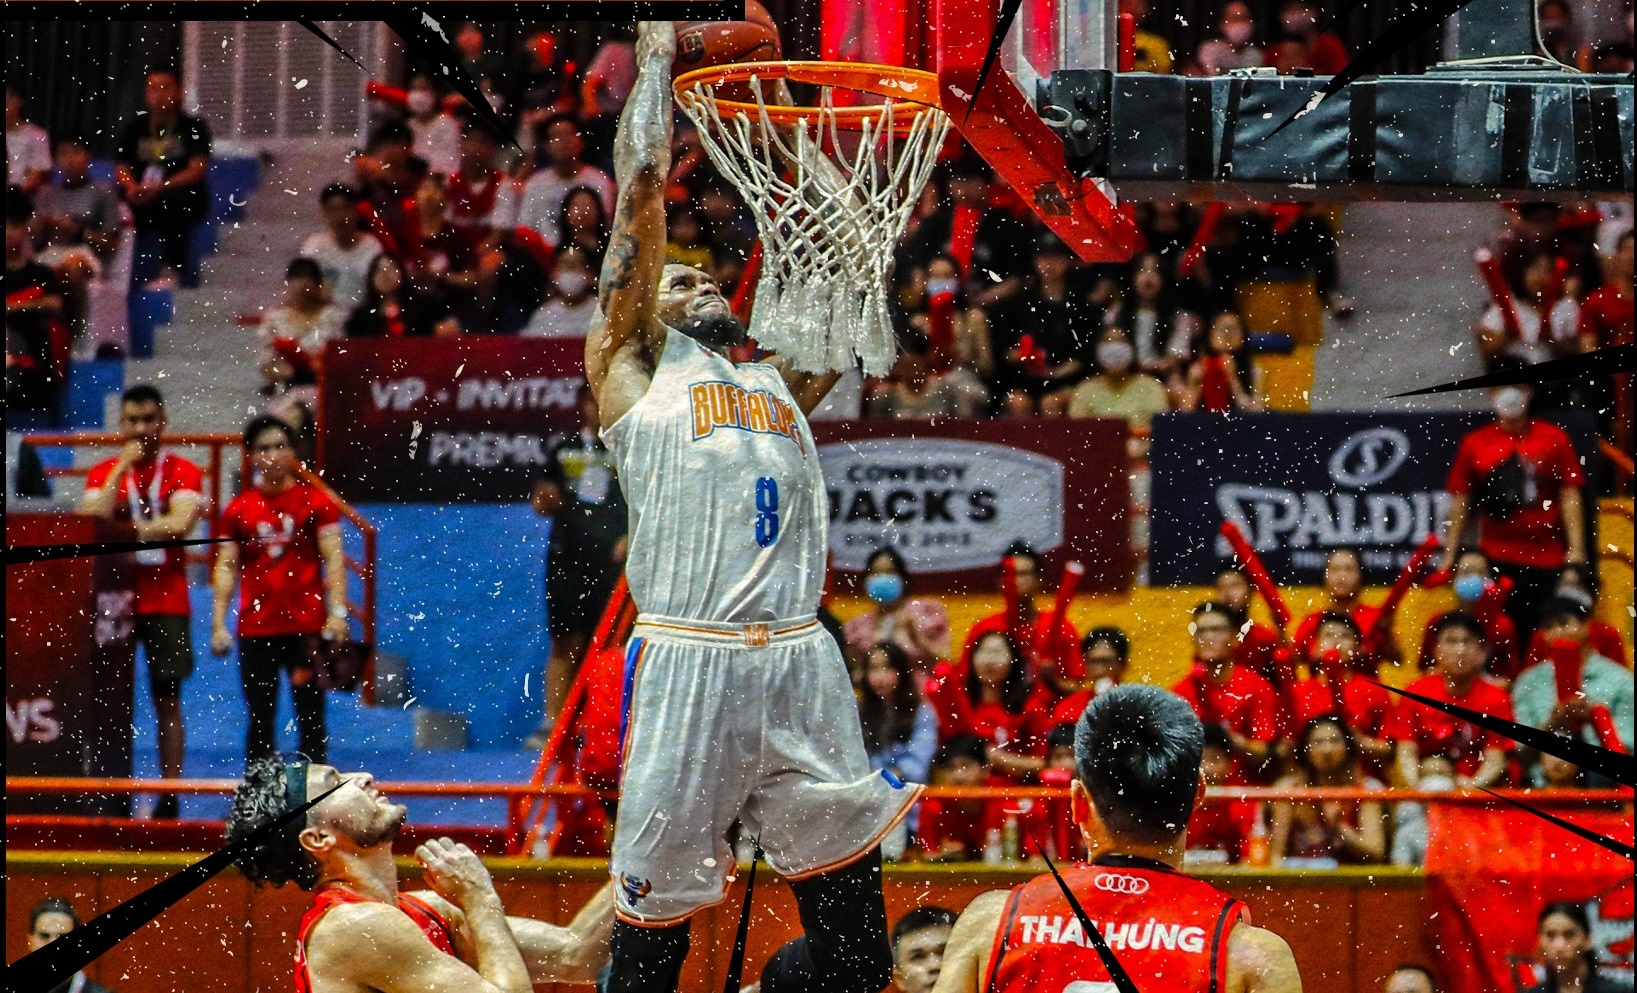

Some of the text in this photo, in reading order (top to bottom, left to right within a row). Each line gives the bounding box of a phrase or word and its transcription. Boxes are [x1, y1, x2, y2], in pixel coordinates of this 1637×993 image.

[371, 377, 426, 409] VIP
[846, 464, 967, 483] COWBOY
[755, 476, 779, 548] 8
